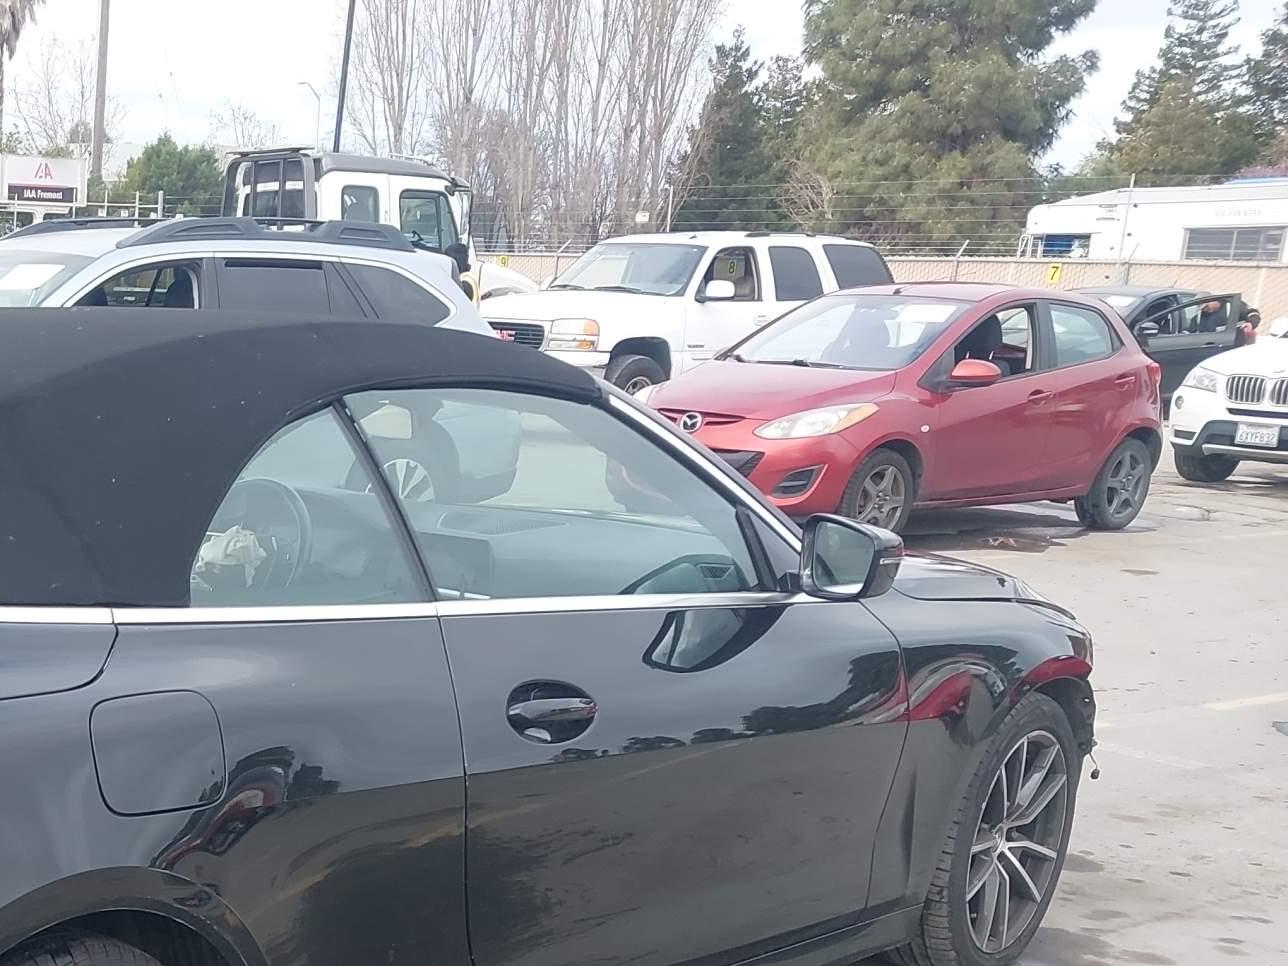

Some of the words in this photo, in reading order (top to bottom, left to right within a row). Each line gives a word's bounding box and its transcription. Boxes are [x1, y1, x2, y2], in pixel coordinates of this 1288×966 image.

[23, 189, 36, 198] IAA
[37, 189, 63, 200] Fremont
[728, 261, 736, 274] 8
[1051, 265, 1060, 281] 7
